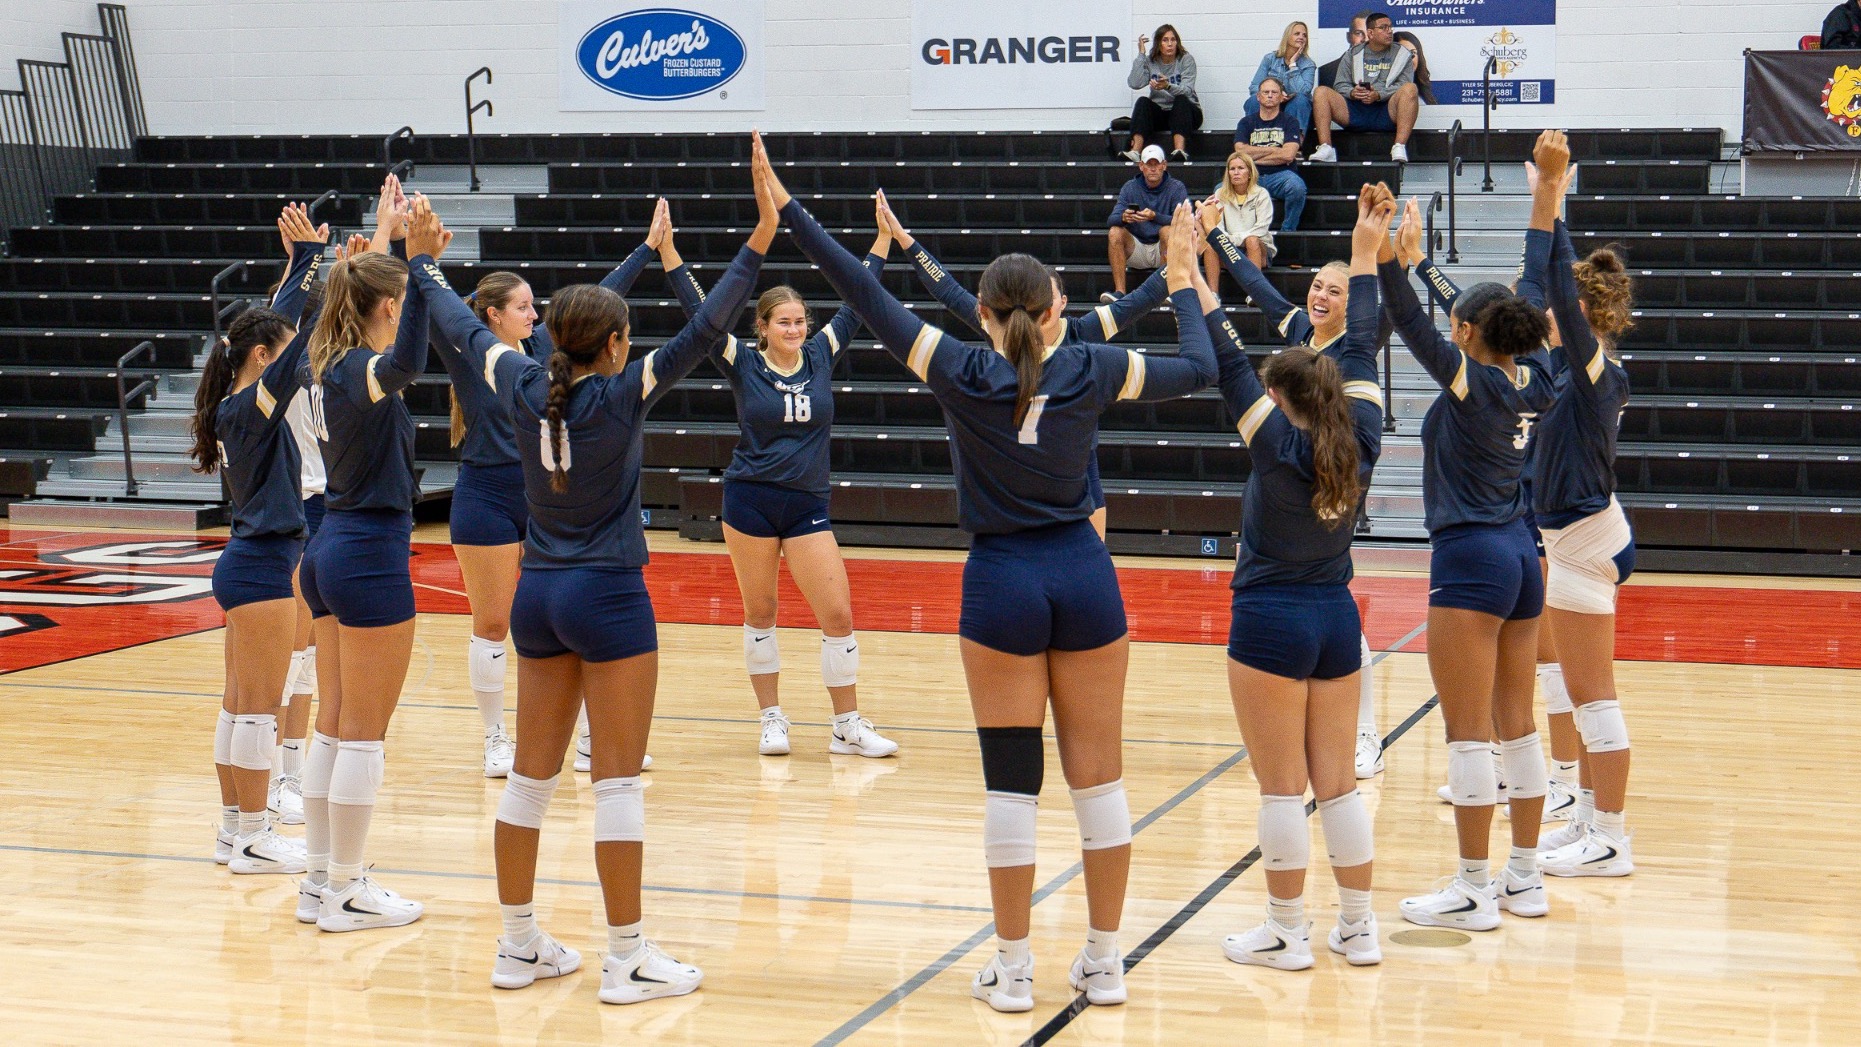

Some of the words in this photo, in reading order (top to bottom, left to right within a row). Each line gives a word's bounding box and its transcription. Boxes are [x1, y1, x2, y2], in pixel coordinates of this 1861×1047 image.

[1405, 7, 1466, 16] INSURANCE
[595, 19, 710, 80] Culver's
[921, 35, 1121, 66] GRANGER
[1480, 46, 1528, 60] Schuberg
[1216, 233, 1242, 264] PRAIRIE
[915, 250, 946, 282] PRAIRIE
[1425, 265, 1457, 300] PRAIRIE
[783, 392, 812, 423] 18
[1017, 394, 1049, 445] 7
